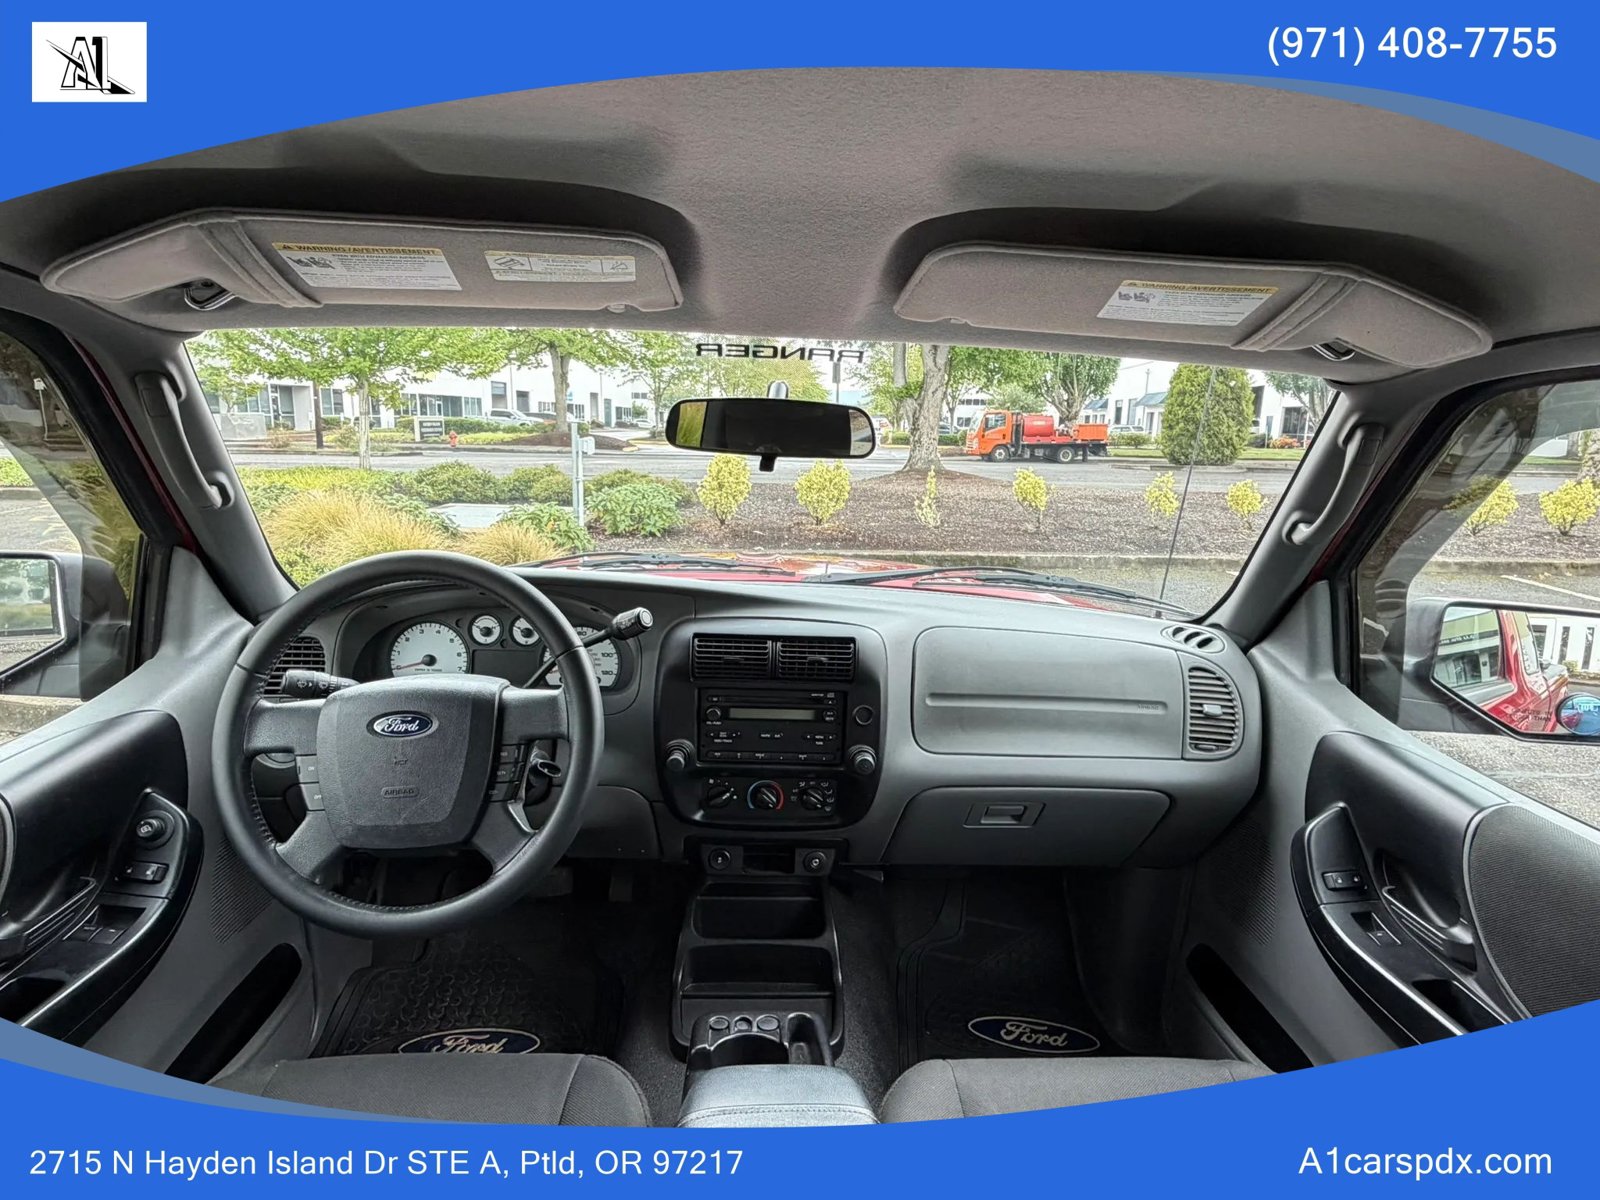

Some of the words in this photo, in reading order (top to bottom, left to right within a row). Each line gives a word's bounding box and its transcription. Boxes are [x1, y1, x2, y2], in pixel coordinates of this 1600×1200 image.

[294, 244, 346, 253] WARNING
[384, 716, 419, 732] Ford
[384, 788, 415, 796] AIRBAG
[1000, 1021, 1068, 1047] Ford
[432, 1034, 508, 1053] Ford
